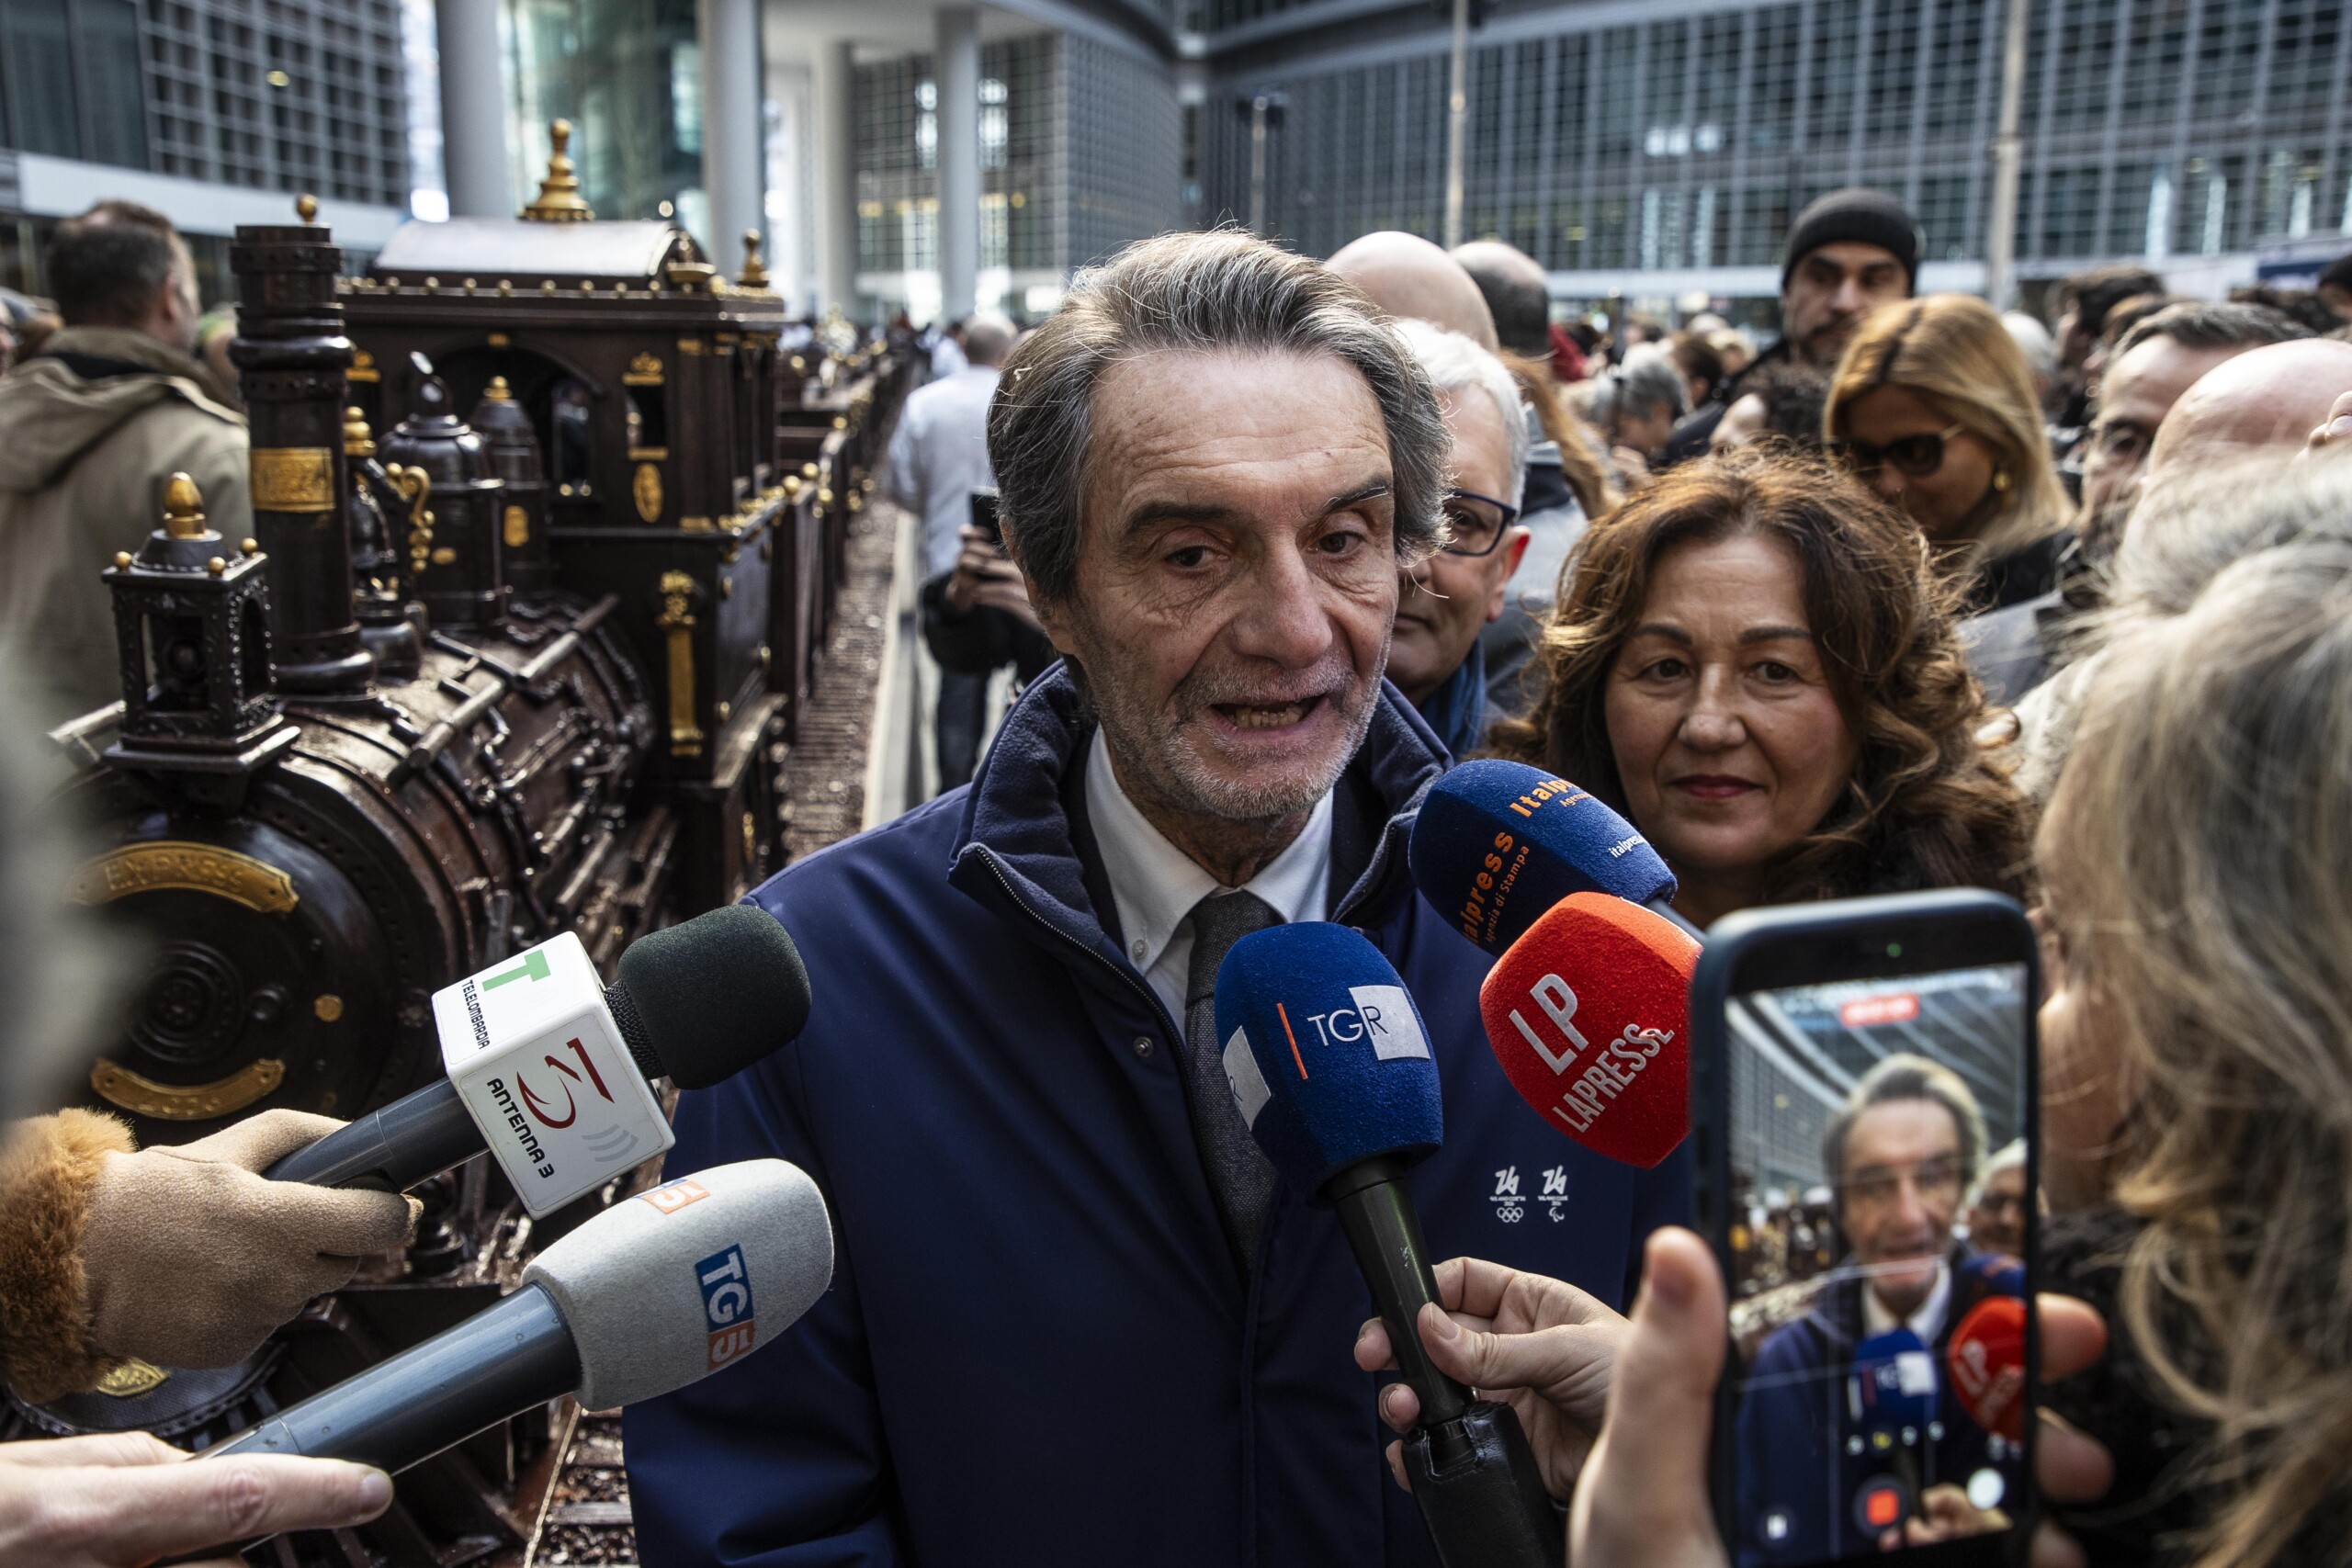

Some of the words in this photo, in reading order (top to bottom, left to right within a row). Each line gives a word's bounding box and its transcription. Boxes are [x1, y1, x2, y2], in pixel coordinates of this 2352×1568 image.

[1499, 846, 1530, 893] Stampa
[462, 979, 491, 1050] TELELOMBARDIA
[1307, 1005, 1390, 1047] TGR
[1509, 974, 1589, 1076] LP
[487, 1077, 545, 1164] ANTENNA
[537, 1158, 556, 1179] 3
[702, 1251, 752, 1363] TG5
